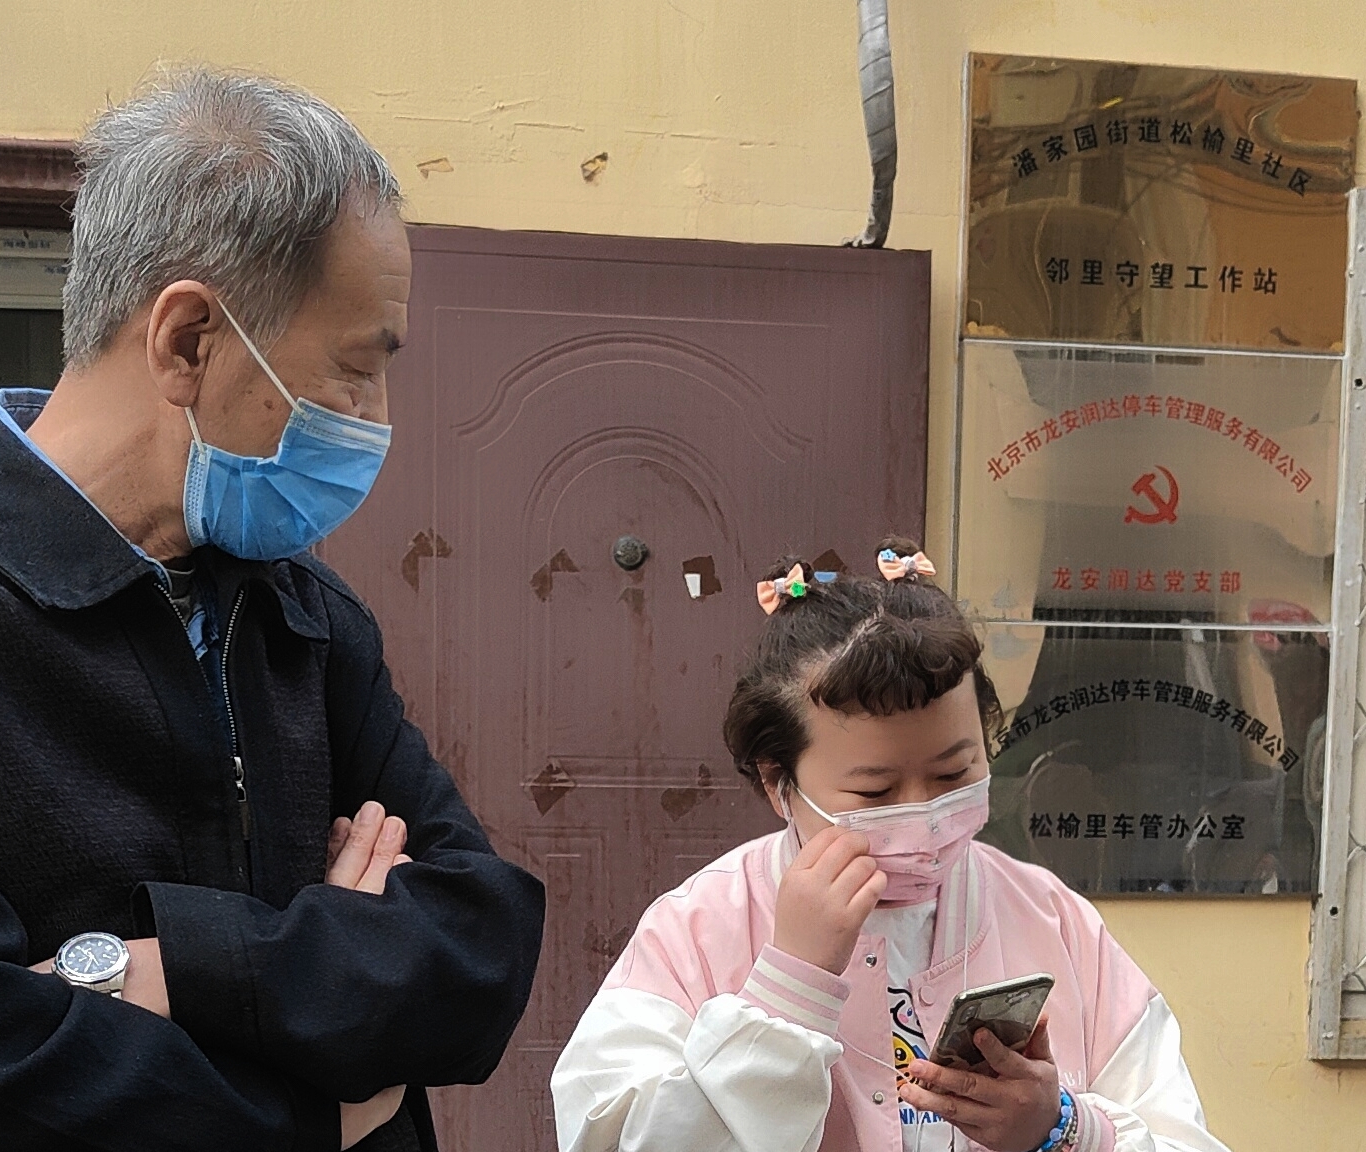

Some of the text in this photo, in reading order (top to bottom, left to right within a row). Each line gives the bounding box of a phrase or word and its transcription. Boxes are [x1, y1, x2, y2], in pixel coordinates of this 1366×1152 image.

[1012, 117, 1313, 197] 潘家园街道松榆里社区
[1045, 257, 1278, 295] 邻里守望工作站
[987, 394, 1313, 493] 北京市龙安润达停车管理服务有限公司
[1052, 566, 1241, 593] 龙安润达党支部
[1029, 812, 1245, 840] 松榆里车管办公室
